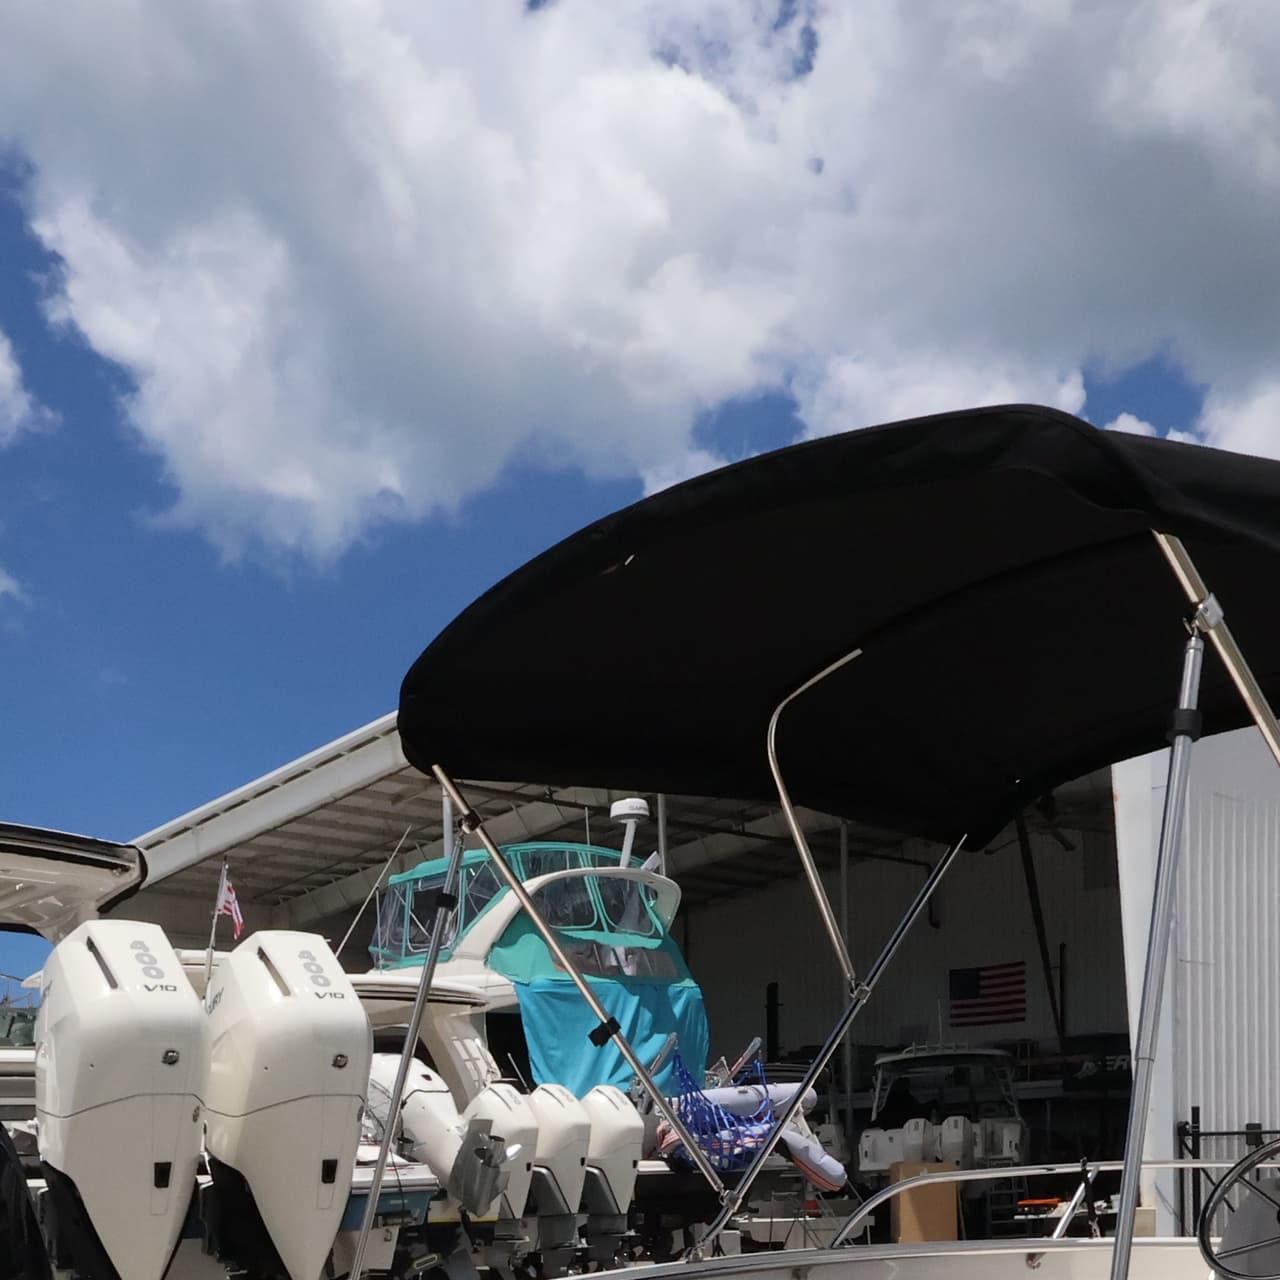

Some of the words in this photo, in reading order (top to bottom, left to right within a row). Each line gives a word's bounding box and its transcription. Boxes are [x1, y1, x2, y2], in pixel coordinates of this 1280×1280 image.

[130, 940, 165, 979] 400
[298, 950, 331, 987] 400
[144, 984, 177, 992] V10
[314, 991, 345, 1000] V10
